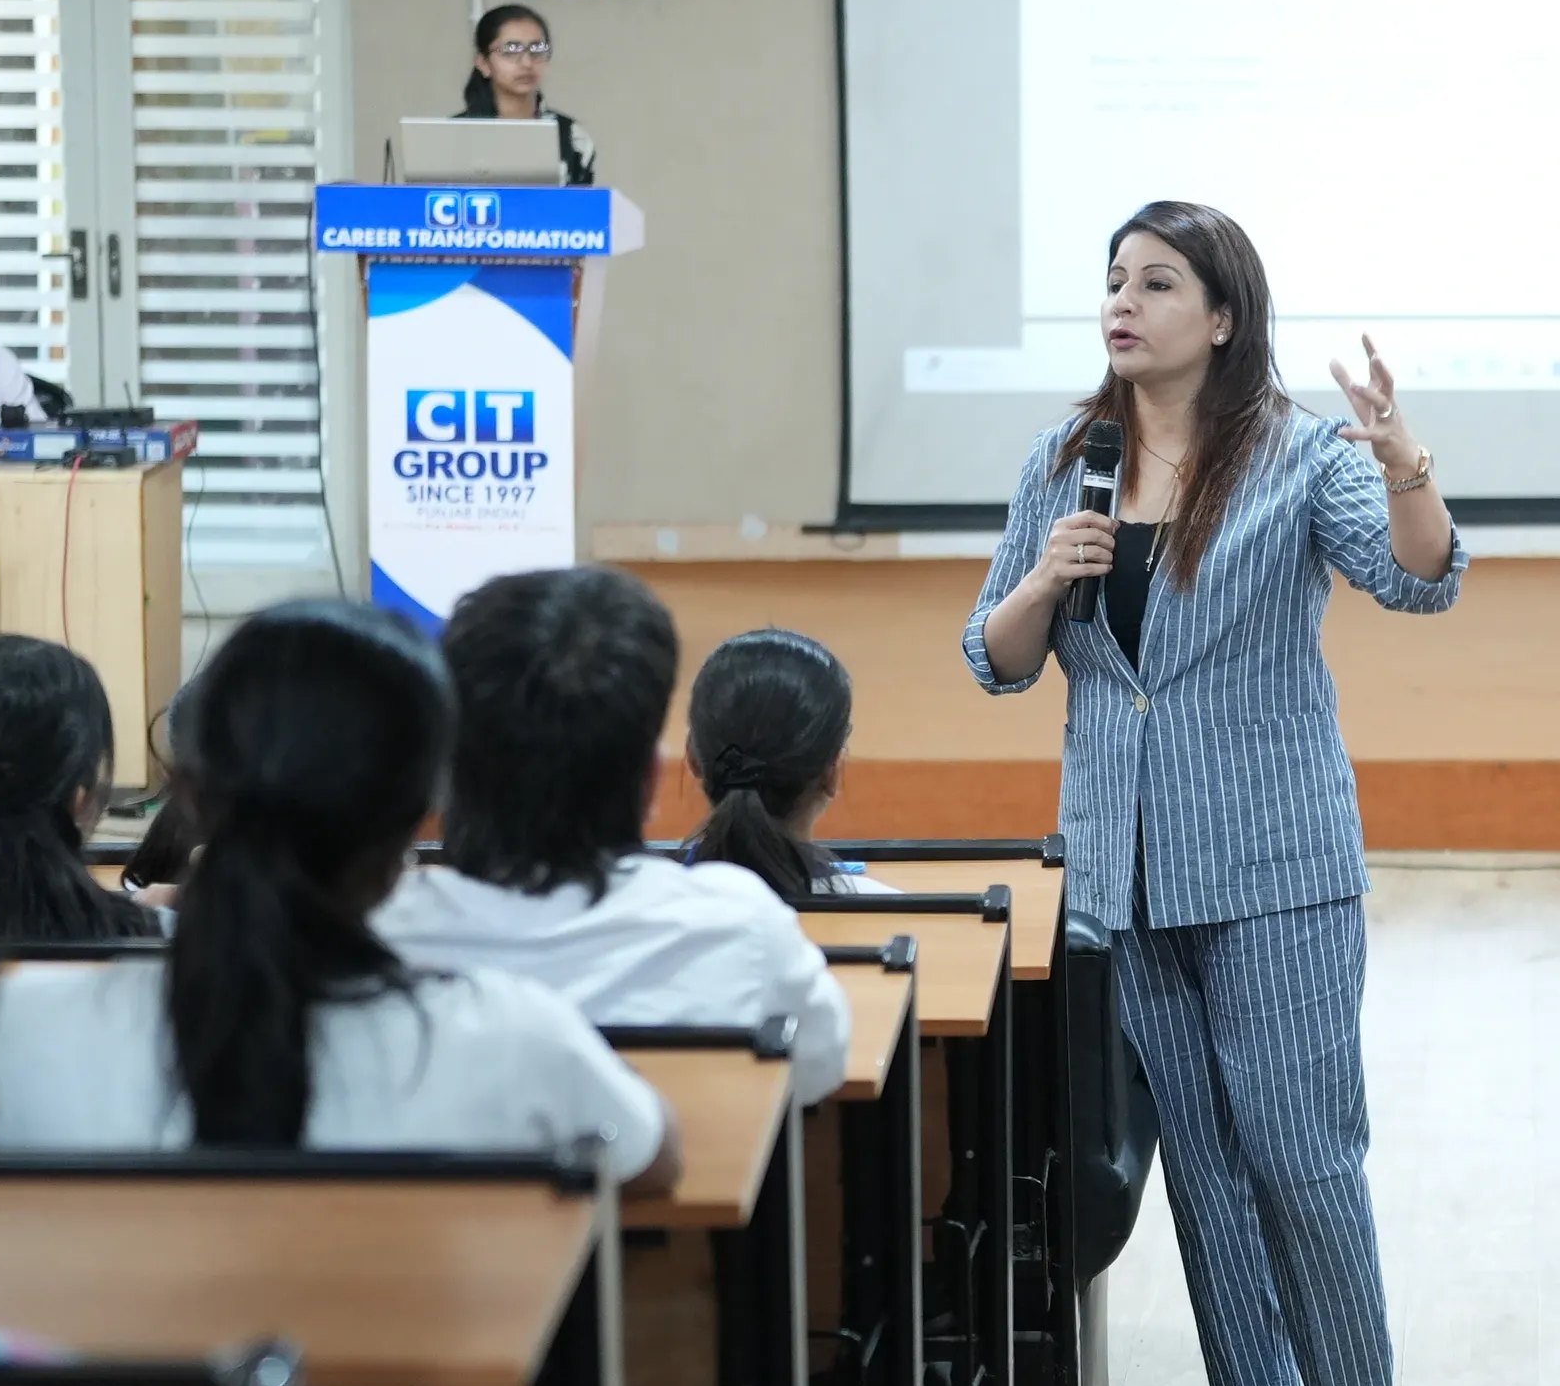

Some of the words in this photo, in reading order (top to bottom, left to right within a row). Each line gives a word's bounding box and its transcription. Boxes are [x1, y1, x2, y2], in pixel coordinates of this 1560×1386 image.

[430, 195, 494, 227] CT
[322, 228, 401, 249] CAREER
[406, 228, 606, 251] TRANSFORMATION
[413, 391, 526, 443] CT
[393, 449, 549, 481] GROUP
[406, 484, 476, 505] SINCE
[484, 485, 537, 505] 1997
